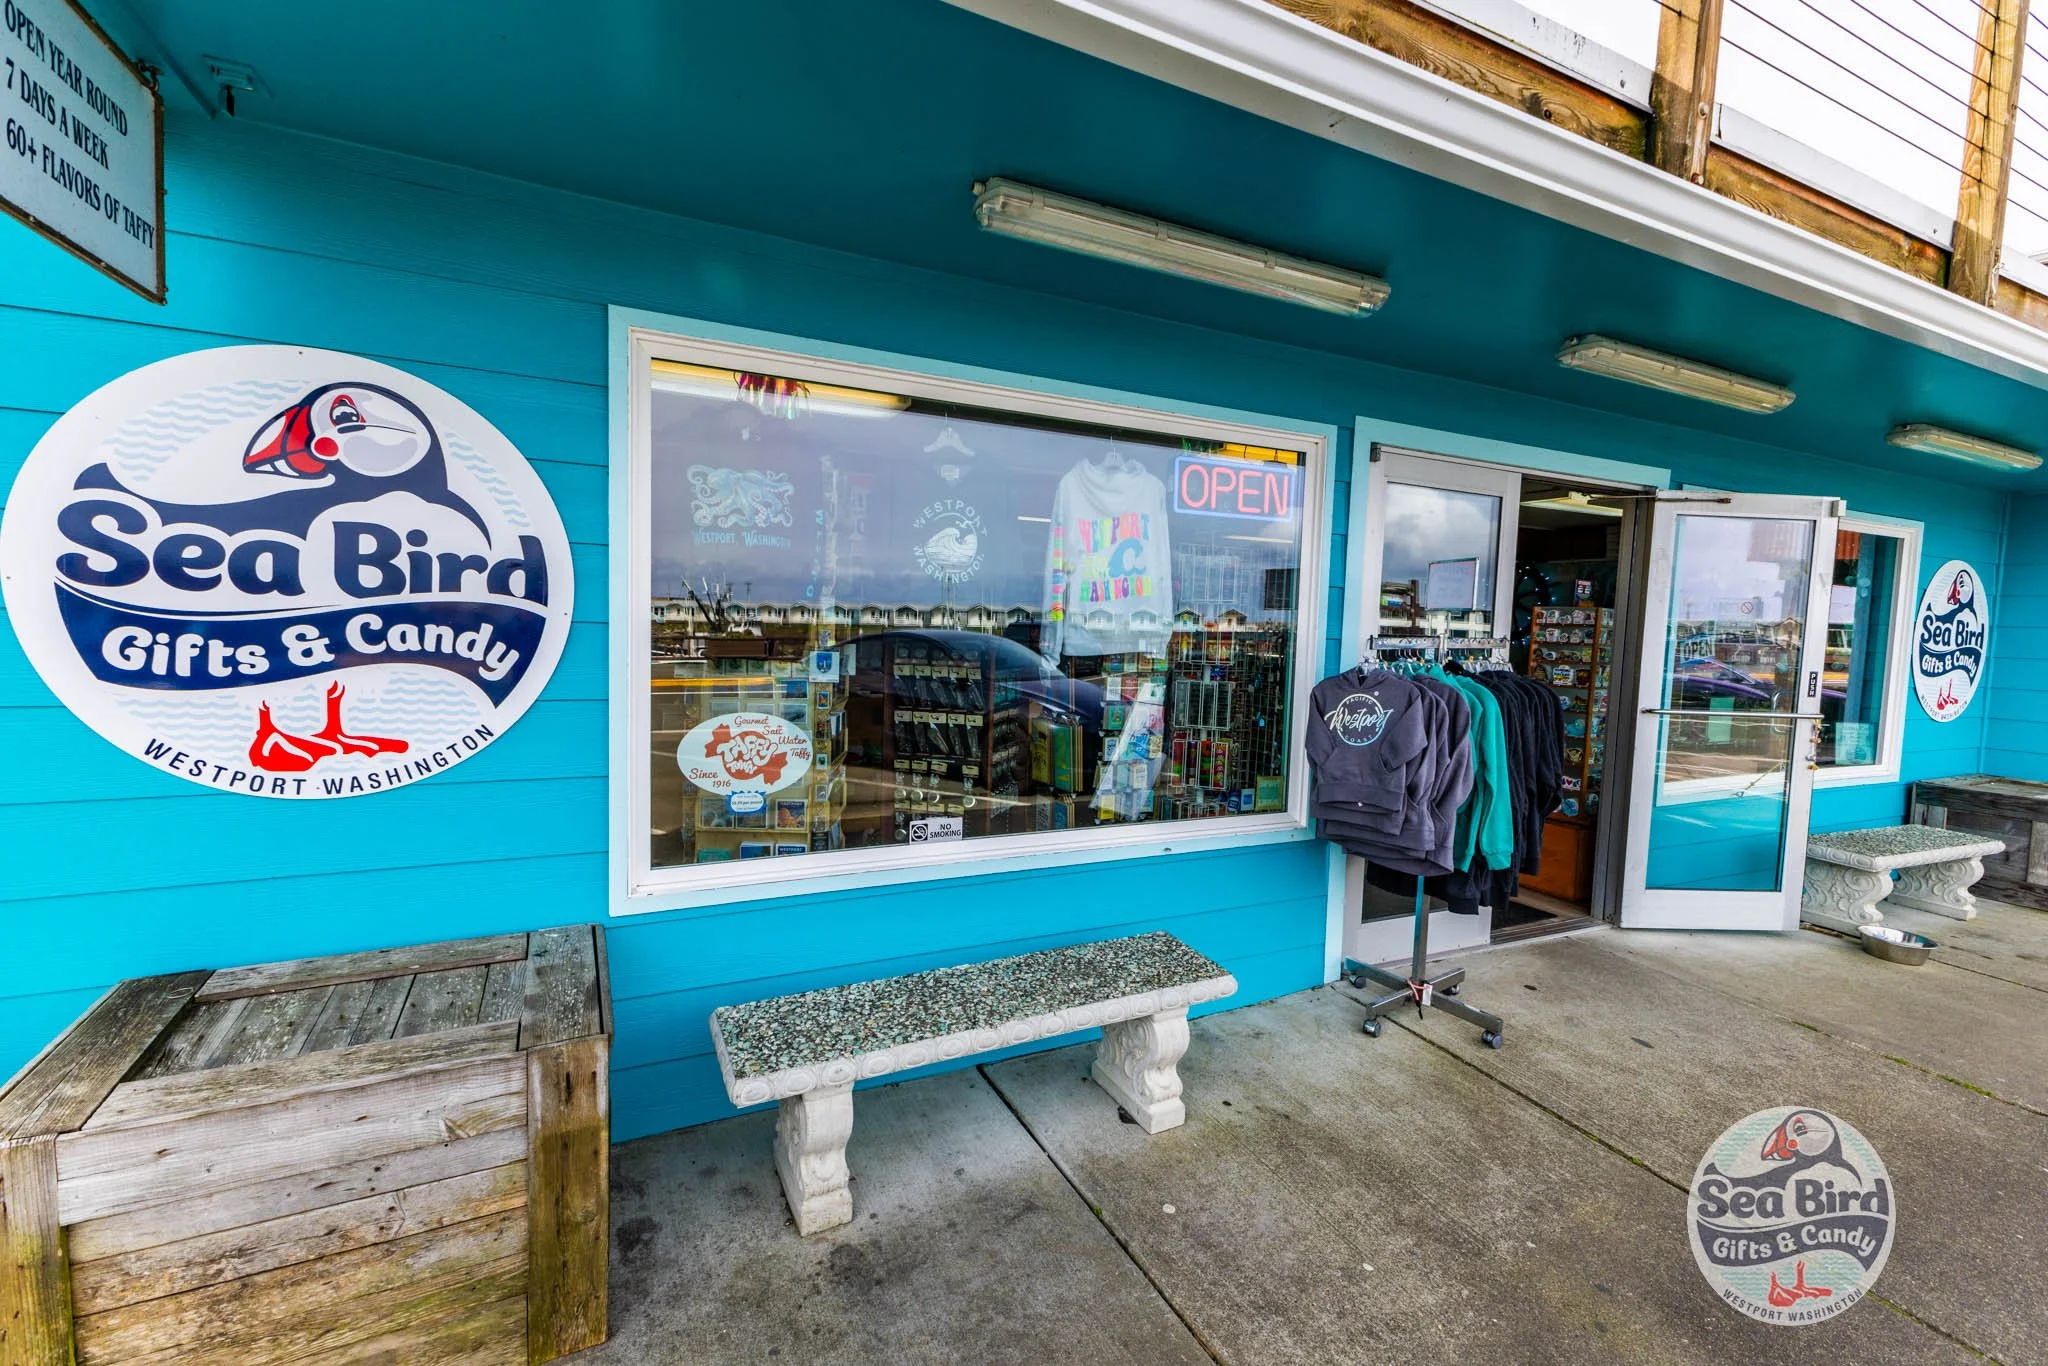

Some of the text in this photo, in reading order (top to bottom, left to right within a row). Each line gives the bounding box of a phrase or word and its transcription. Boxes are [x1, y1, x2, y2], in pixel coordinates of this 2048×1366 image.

[5, 0, 128, 137] OPEN YEAR ROUND
[5, 57, 109, 170] 7 DAYS A WEEK
[6, 118, 155, 250] 60+ FLAVORS OF TAFFY
[1181, 464, 1289, 515] OPEN
[56, 499, 548, 607] Sea Bird
[1920, 614, 1985, 650] Sea Bird
[101, 614, 520, 681] Gifts & Candy
[1684, 638, 1713, 660] OPEN
[1922, 650, 1977, 678] Gifts & Candy
[1345, 696, 1373, 705] PACIFIC
[734, 715, 769, 727] Gourmet
[762, 725, 784, 736] Salt
[1324, 706, 1394, 732] Westport
[778, 736, 807, 746] Water
[144, 723, 495, 796] WESTPORT WASHINGTON
[790, 748, 811, 760] Taffy
[689, 768, 719, 780] Since
[712, 780, 732, 788] 1916
[929, 829, 962, 839] SMOKING
[939, 823, 952, 831] NO
